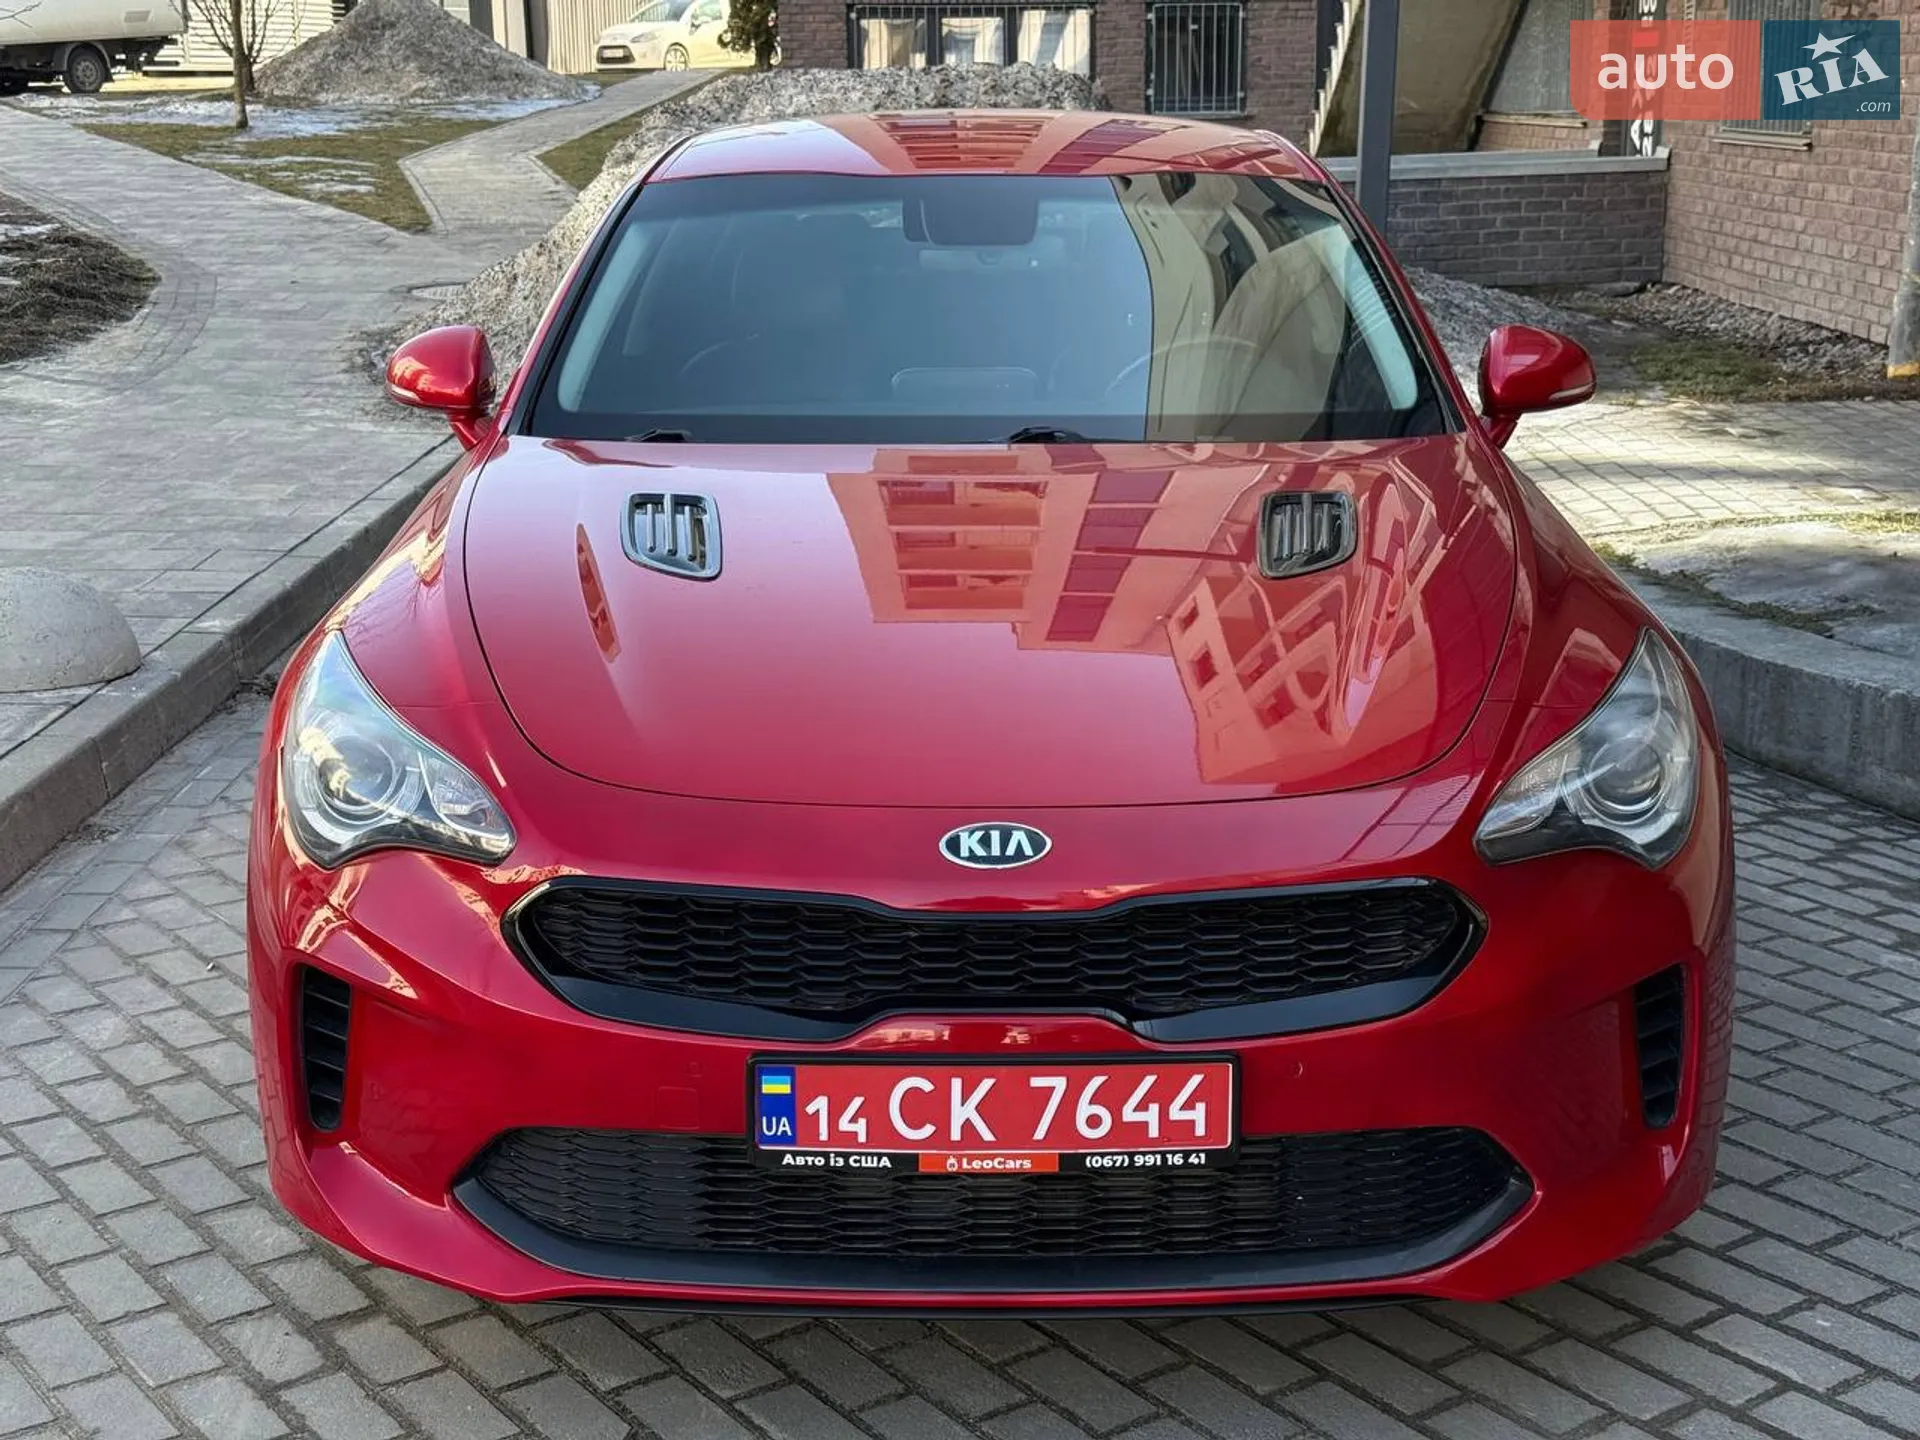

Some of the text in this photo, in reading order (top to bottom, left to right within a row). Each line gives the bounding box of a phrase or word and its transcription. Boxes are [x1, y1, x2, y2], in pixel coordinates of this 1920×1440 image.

[958, 829, 1034, 857] KIA
[805, 1095, 868, 1143] 14
[1029, 1074, 1207, 1141] 7644
[762, 1116, 792, 1137] UA
[781, 1153, 892, 1168] Авто із США
[962, 1157, 1032, 1169] LeoCars
[1085, 1152, 1206, 1168] (067) 991 16 41
